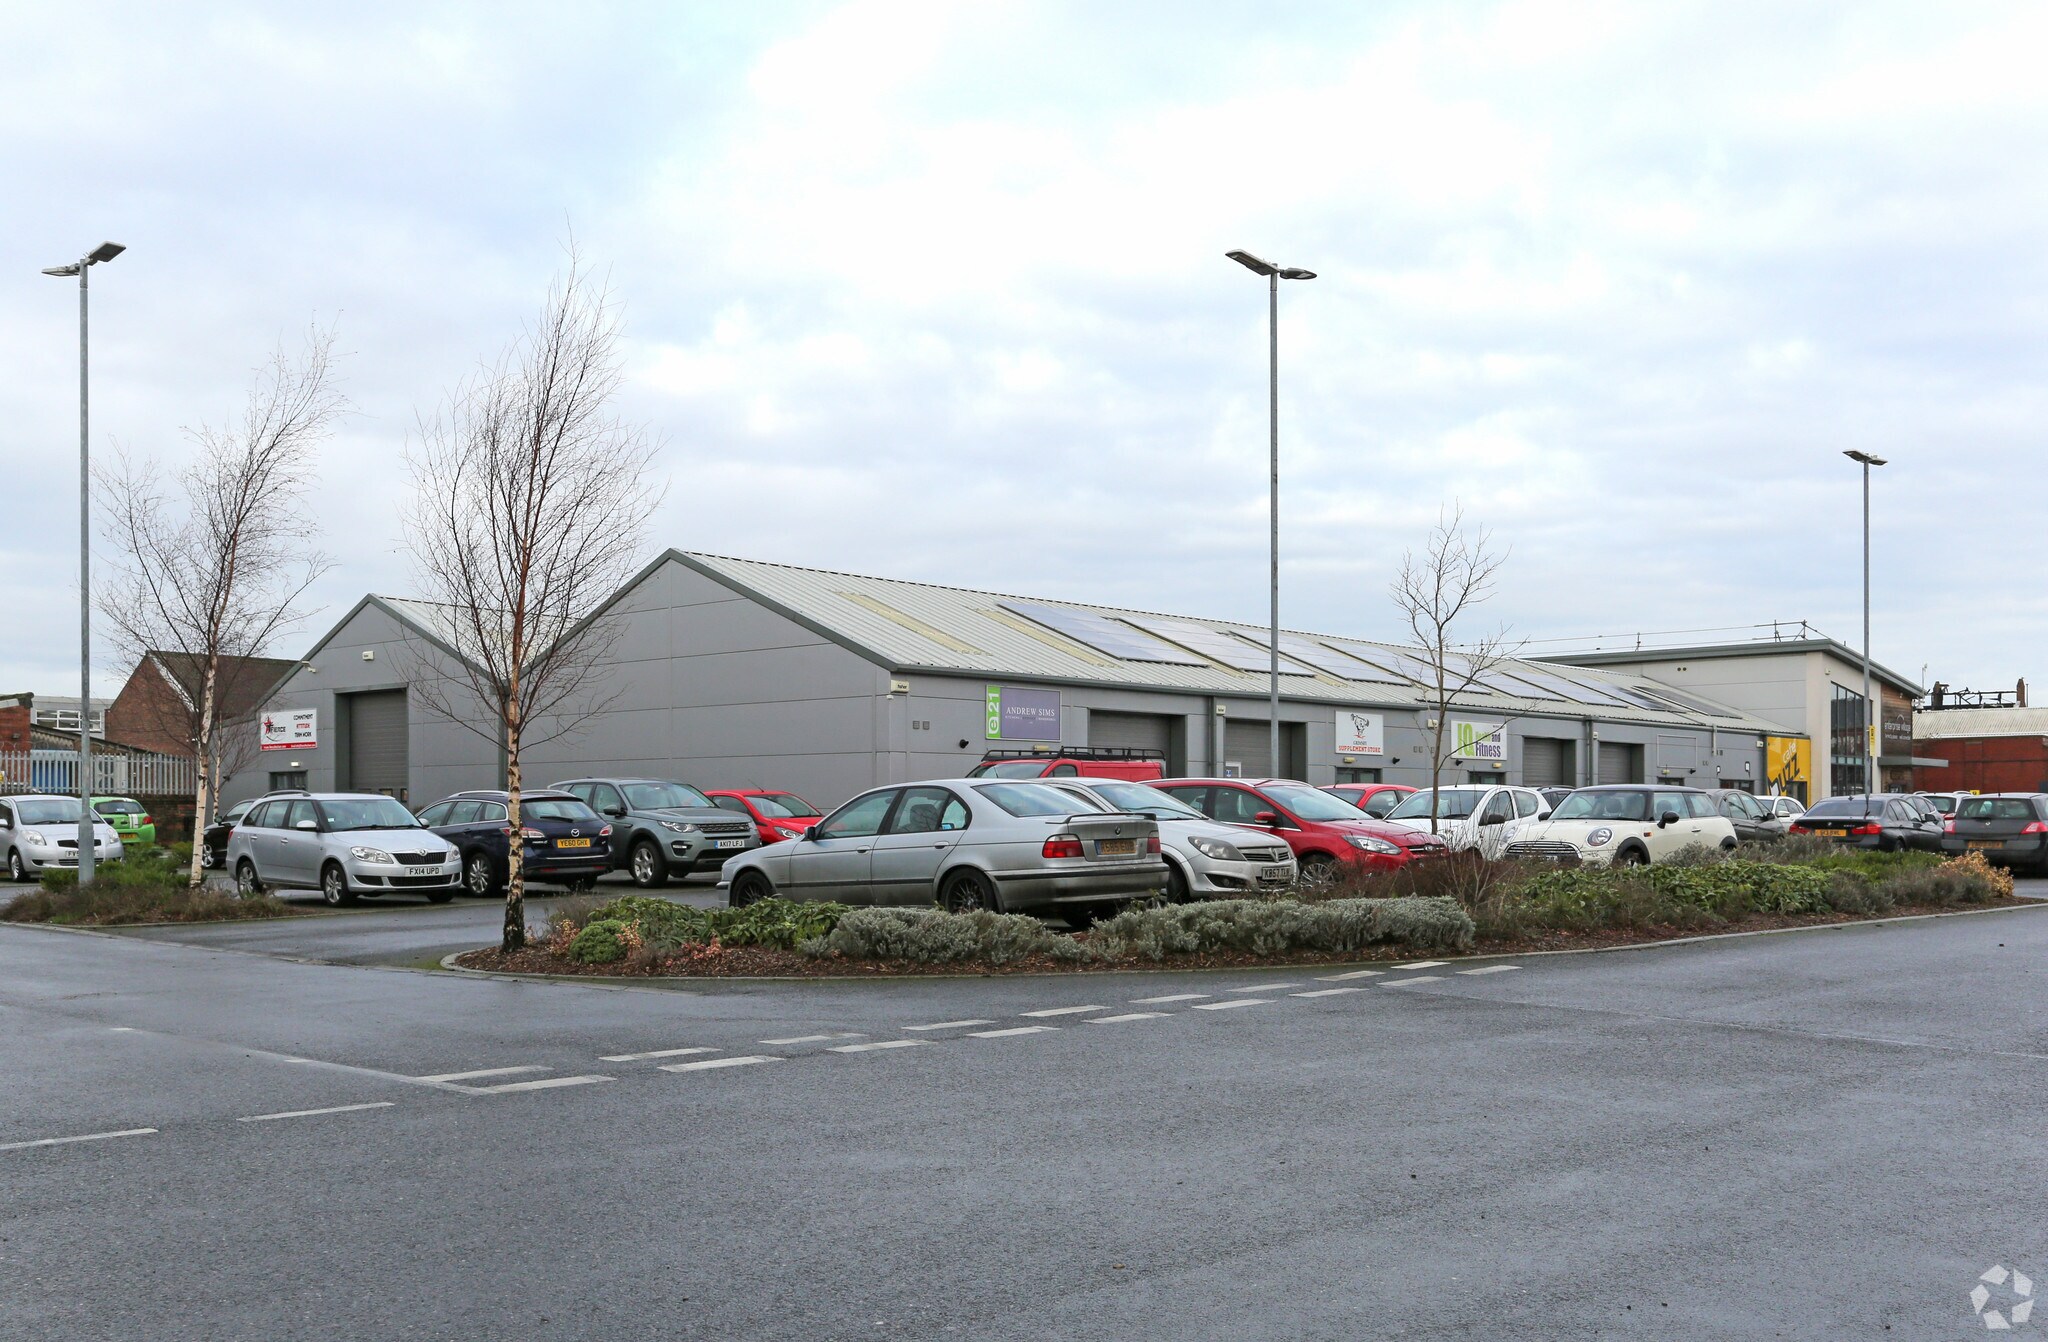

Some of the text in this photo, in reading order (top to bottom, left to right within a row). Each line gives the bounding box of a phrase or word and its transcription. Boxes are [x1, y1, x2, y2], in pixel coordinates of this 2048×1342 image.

[1006, 706, 1055, 717] ANDREW SIMS
[1457, 722, 1475, 757] IQ
[1491, 732, 1501, 743] and
[1475, 740, 1502, 758] Fitness
[409, 867, 425, 875] FX14
